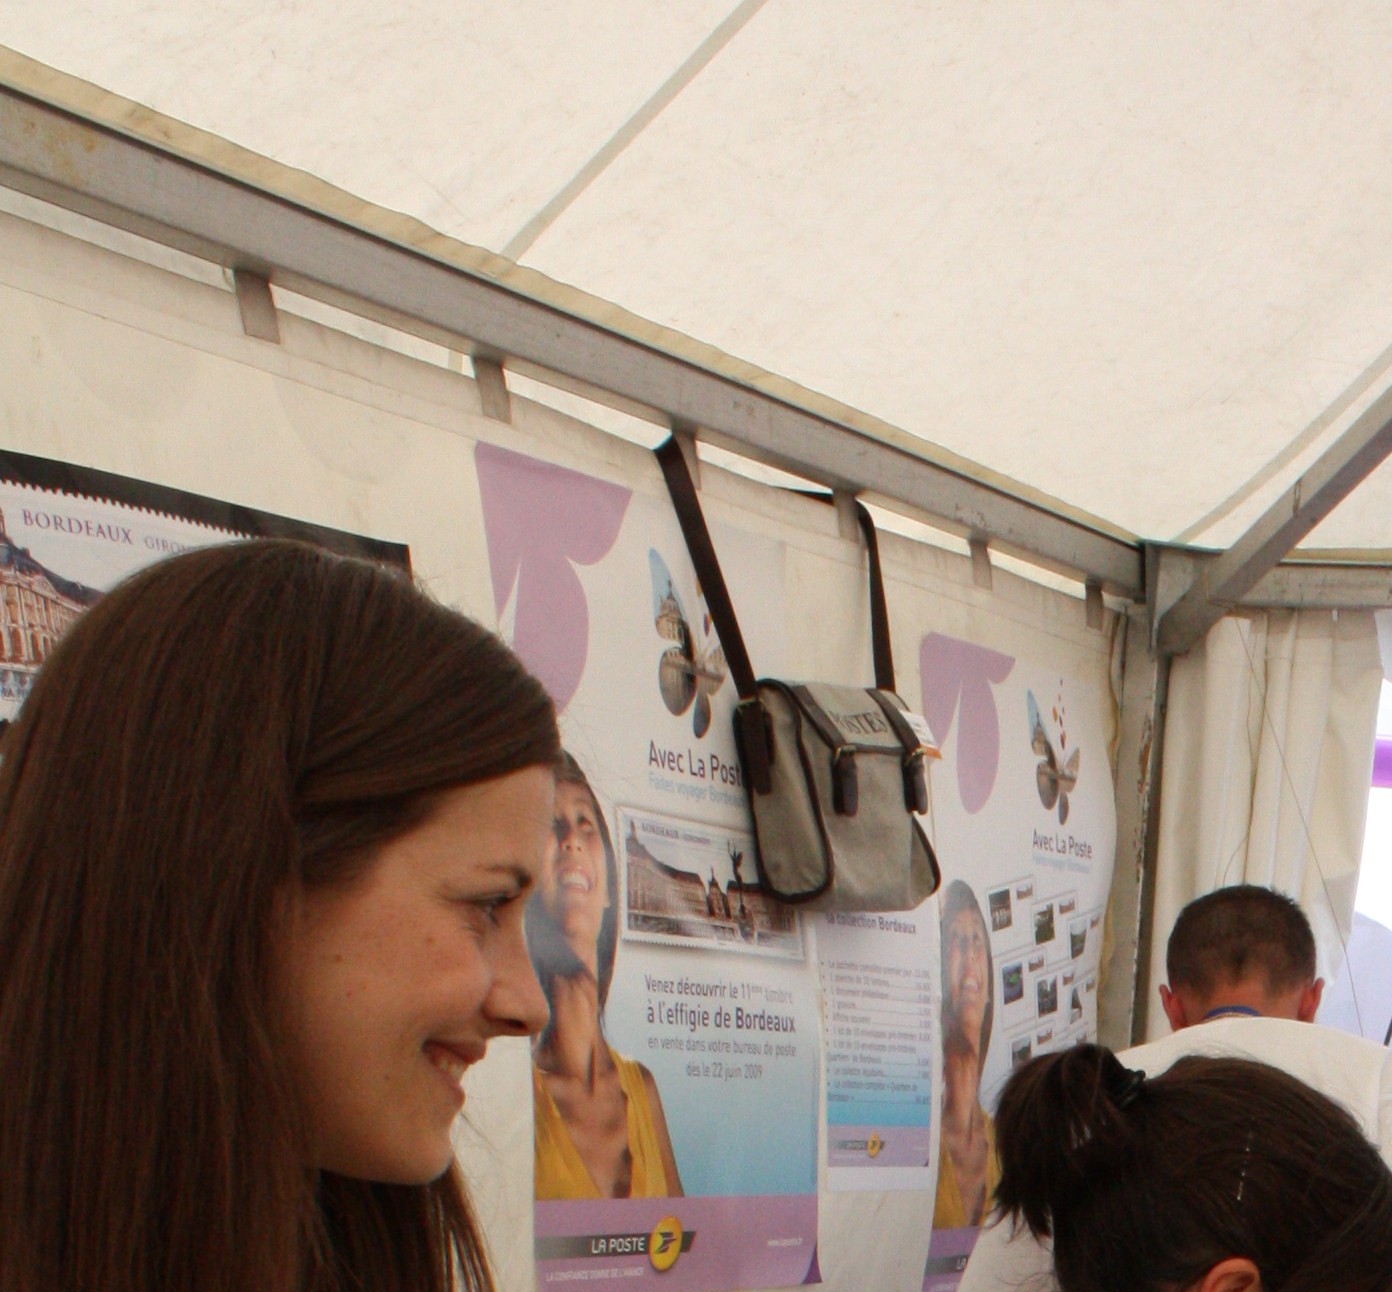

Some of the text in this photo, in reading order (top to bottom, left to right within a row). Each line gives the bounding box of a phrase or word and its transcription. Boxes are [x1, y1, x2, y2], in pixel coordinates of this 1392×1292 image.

[22, 509, 134, 545] BORDEAUX
[649, 739, 743, 788] Avec La Post
[1033, 827, 1053, 852] Avec
[1055, 832, 1067, 854] La
[645, 974, 675, 994] Venez
[677, 977, 727, 998] découvrir
[729, 982, 738, 999] le
[647, 998, 796, 1033] à l'effigie de Bordeaux
[660, 1037, 684, 1051] vente
[707, 1040, 731, 1053] votre
[712, 1062, 723, 1078] 22
[591, 1237, 646, 1254] LA POSTE
